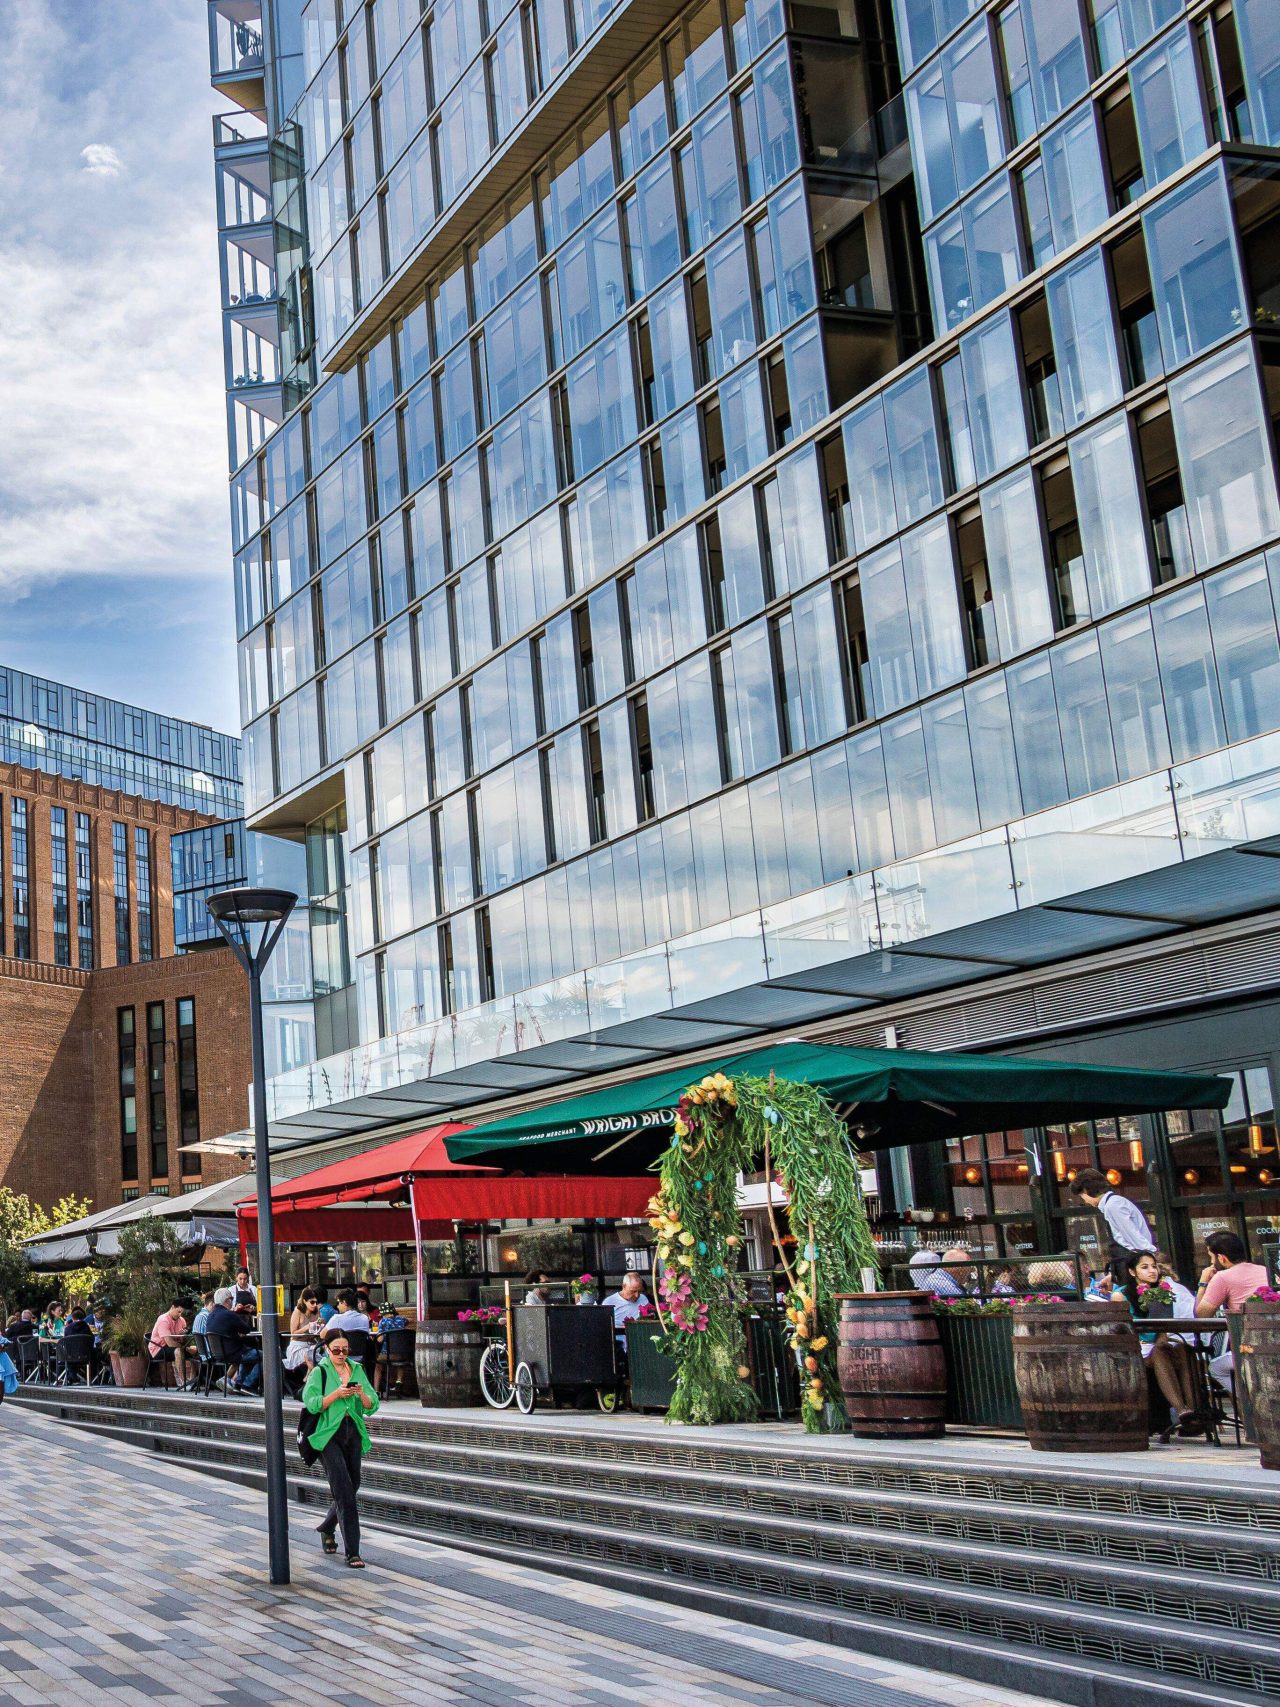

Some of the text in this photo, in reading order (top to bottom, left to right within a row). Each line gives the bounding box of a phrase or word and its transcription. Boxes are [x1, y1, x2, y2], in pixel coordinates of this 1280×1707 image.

[579, 1115, 638, 1135] WRIGHT
[545, 1127, 576, 1138] MERCHANT
[1196, 1221, 1229, 1230] CHARCOAL
[845, 1362, 896, 1377] OTHERS
